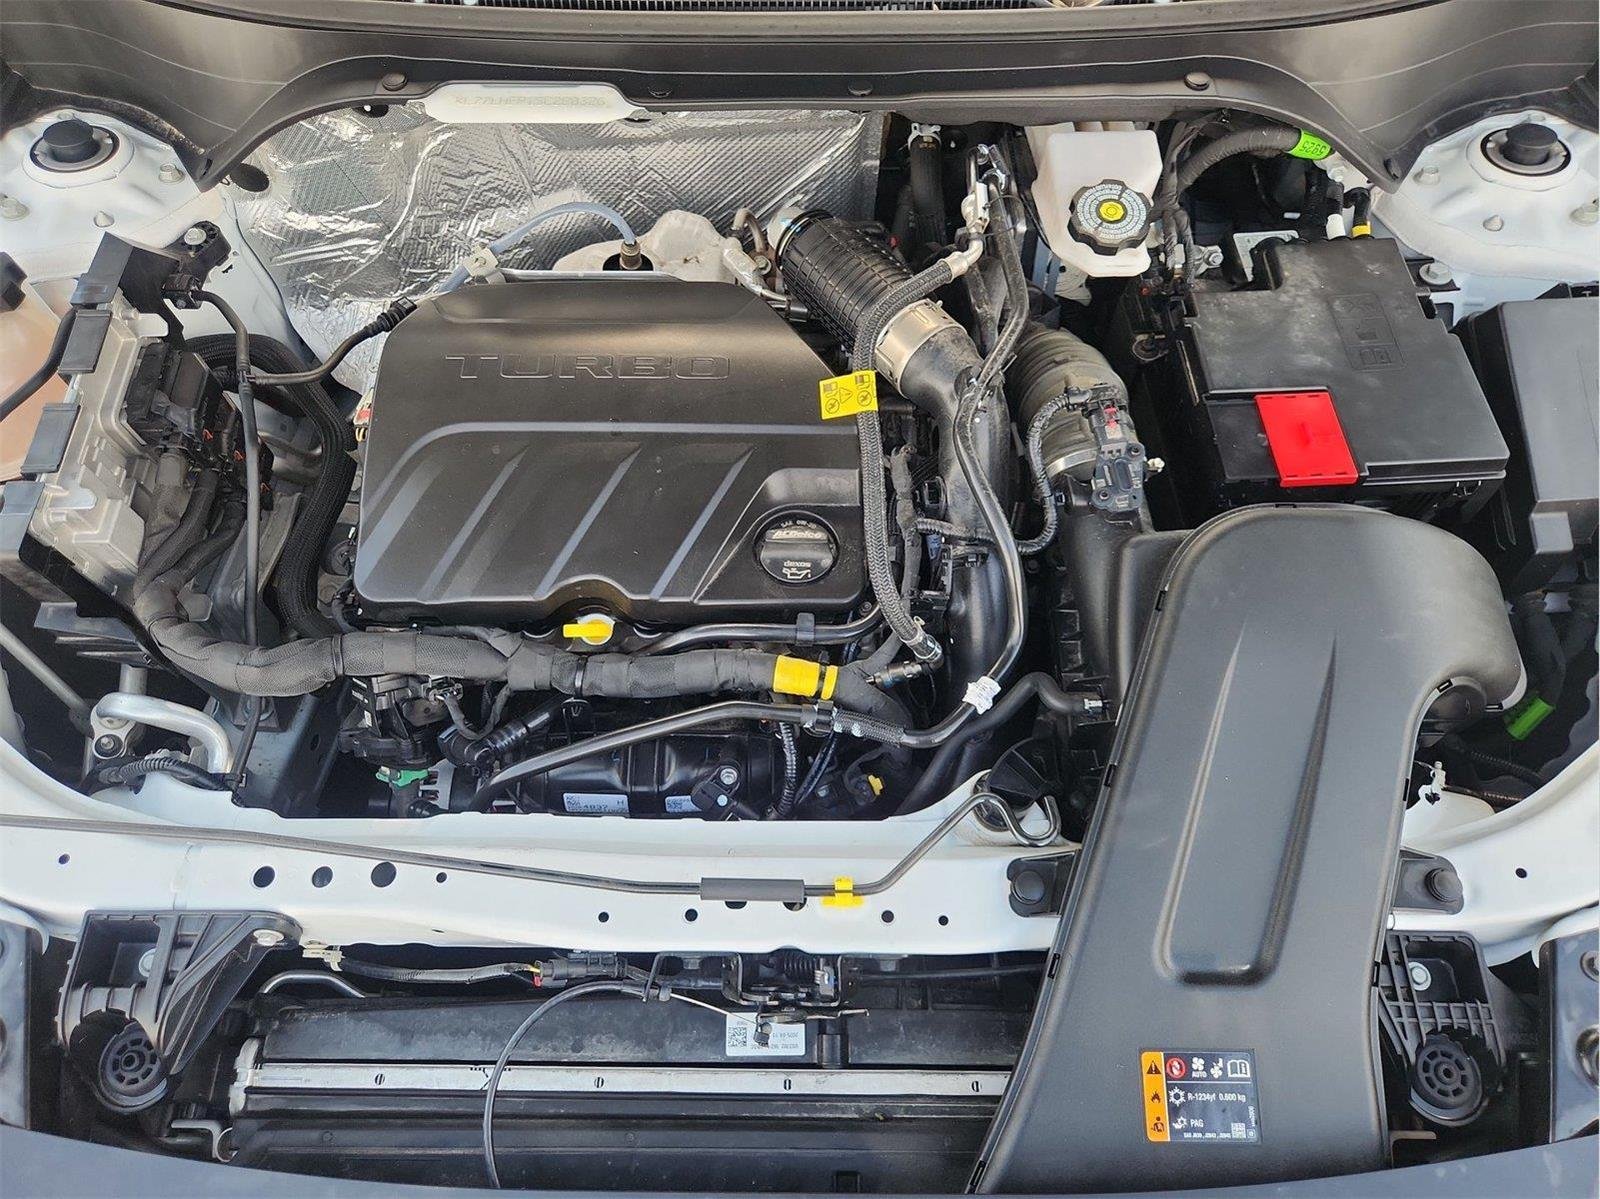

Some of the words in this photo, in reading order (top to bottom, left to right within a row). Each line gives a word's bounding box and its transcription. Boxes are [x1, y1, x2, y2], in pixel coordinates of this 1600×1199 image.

[445, 354, 730, 379] TURBO
[784, 560, 812, 568] dexos
[1187, 1093, 1216, 1102] R-1234yf
[1238, 1093, 1246, 1102] kg
[1190, 1119, 1204, 1128] PAG
